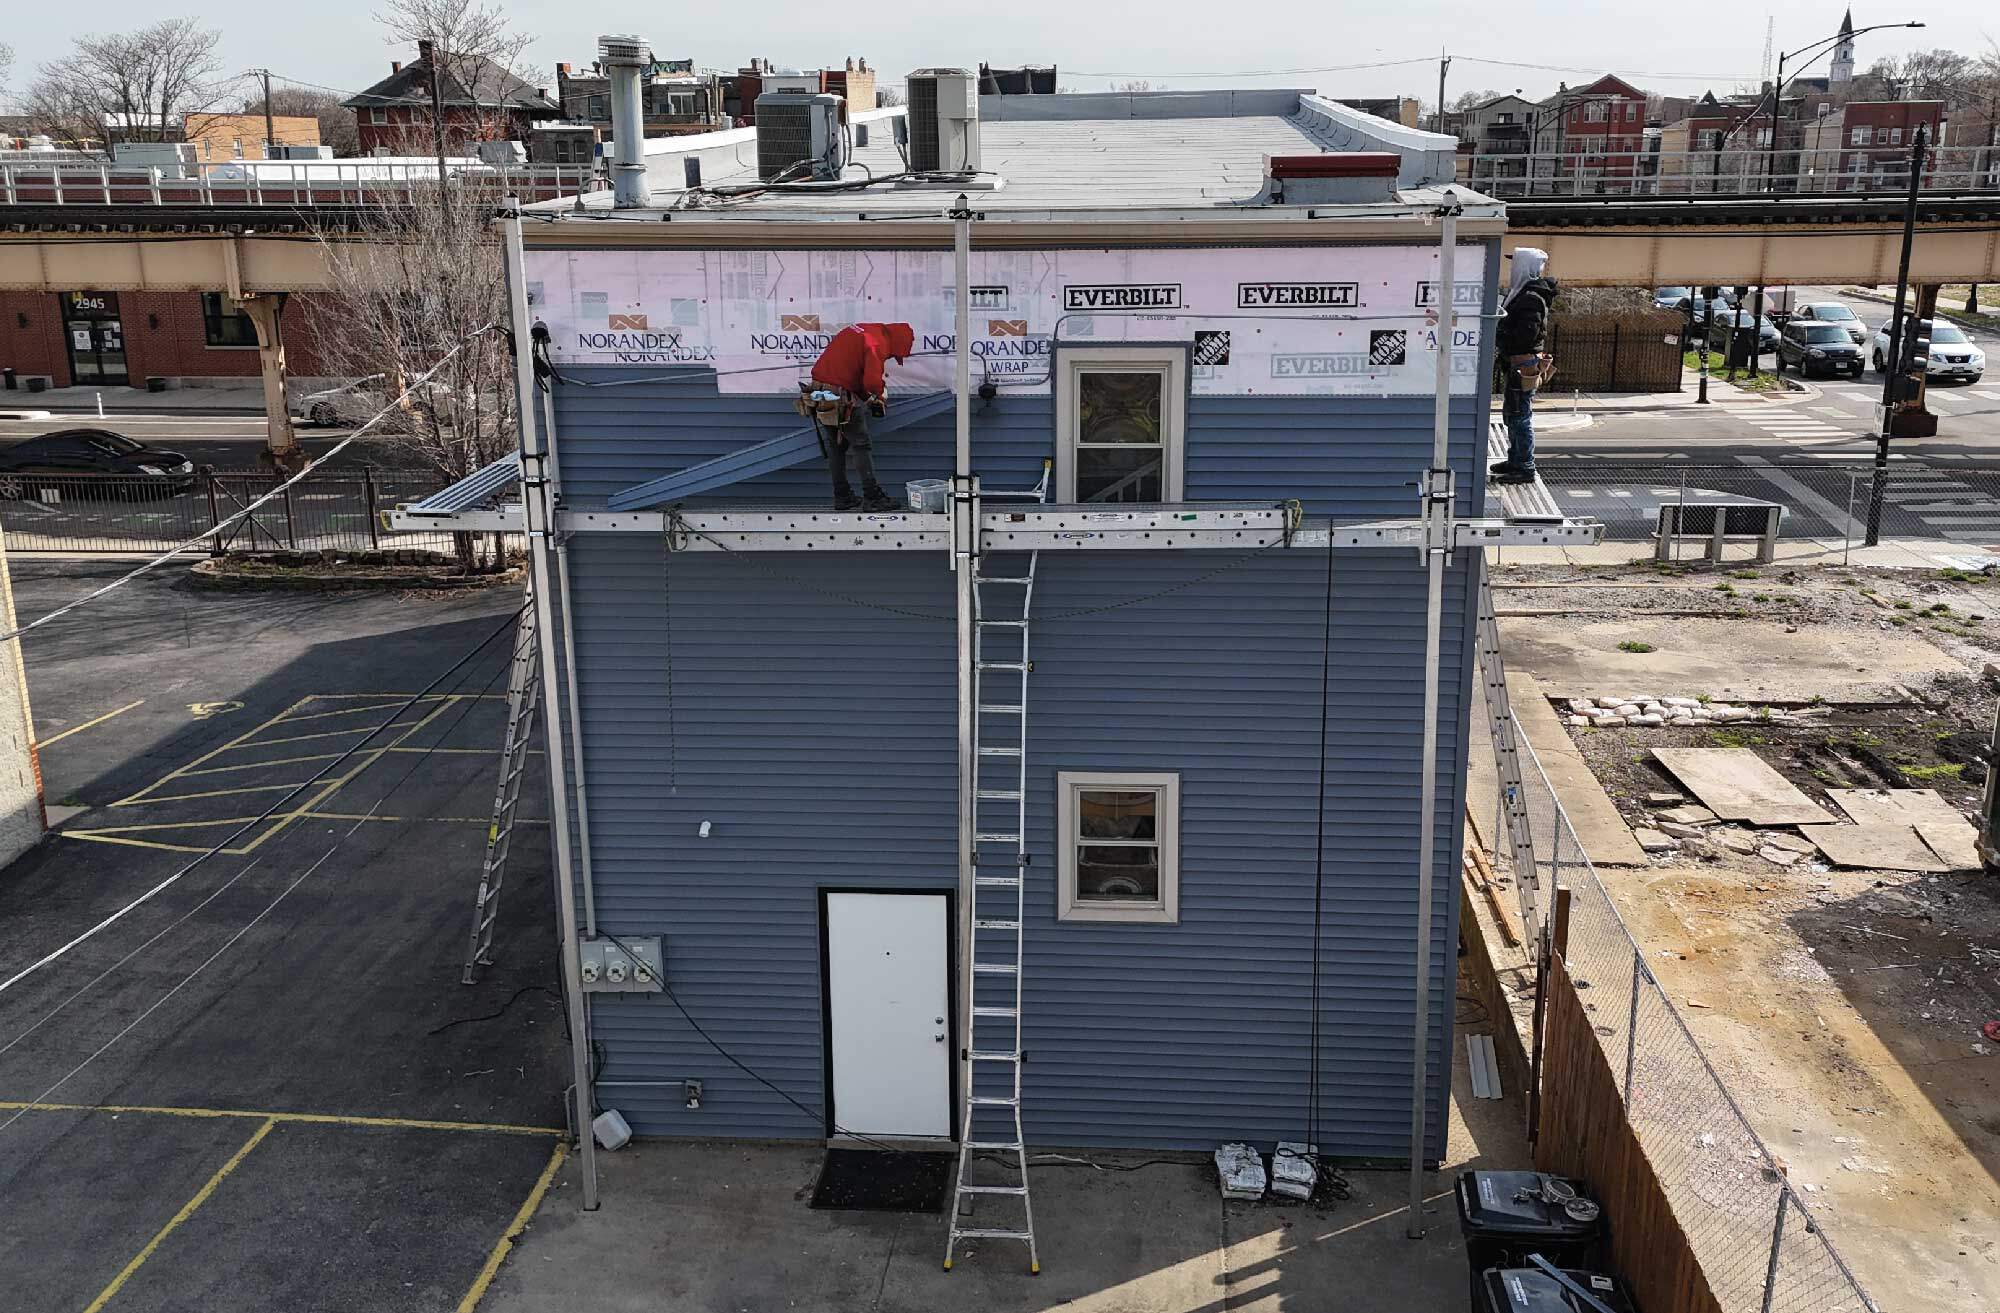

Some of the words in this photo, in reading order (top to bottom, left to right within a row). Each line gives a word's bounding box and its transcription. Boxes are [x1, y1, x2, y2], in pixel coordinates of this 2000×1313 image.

[75, 297, 105, 309] 2945
[1068, 288, 1176, 307] EVERBILT
[1242, 286, 1353, 304] EVERBILT
[578, 333, 681, 349] NORANDEX
[751, 334, 835, 350] NORAND
[970, 340, 1050, 356] ORANDE
[1194, 331, 1230, 365] HOME
[1200, 334, 1213, 348] THE
[1369, 330, 1406, 365] HOME
[1373, 333, 1389, 348] THE
[1208, 345, 1229, 365] DEPOT
[1383, 343, 1406, 365] DEPOT
[990, 361, 1029, 373] WRAP
[1276, 357, 1381, 374] EVERBIL
